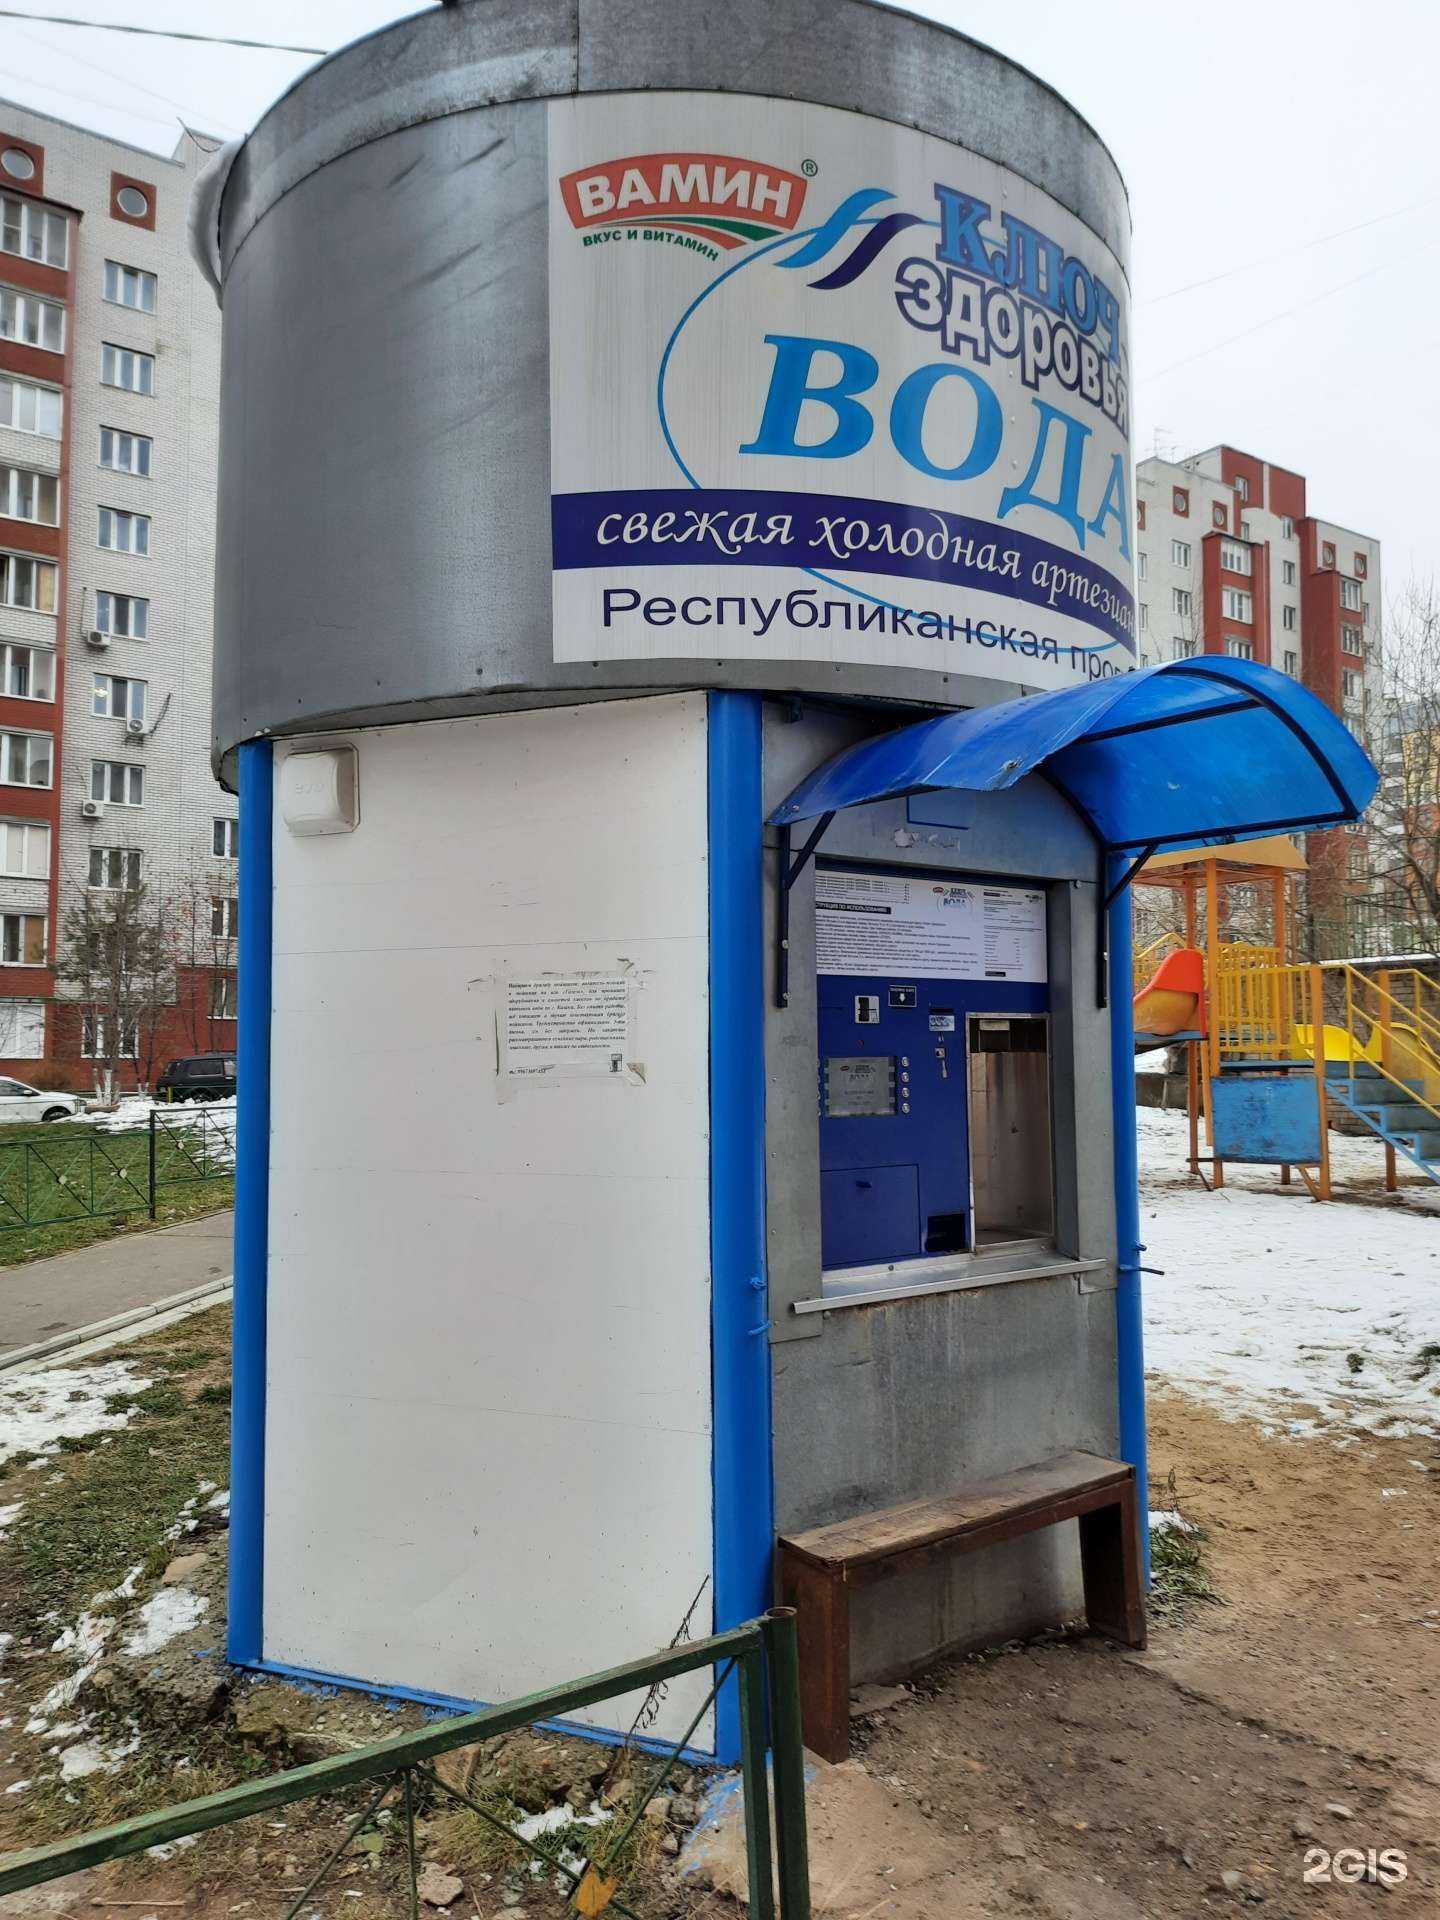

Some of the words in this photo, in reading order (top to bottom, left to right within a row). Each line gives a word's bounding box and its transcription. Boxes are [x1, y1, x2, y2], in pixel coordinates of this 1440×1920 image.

[576, 163, 793, 219] ВАМИН
[583, 230, 622, 247] ВКУС
[627, 230, 639, 241] И
[643, 230, 719, 262] ВИТАМИН
[934, 183, 1120, 365] КЛЮЧ
[739, 334, 1131, 563] ВОДА
[597, 510, 794, 555] свежая
[809, 512, 1021, 578] холодная
[1032, 560, 1136, 640] артезиан
[603, 587, 1059, 664] Республиканская
